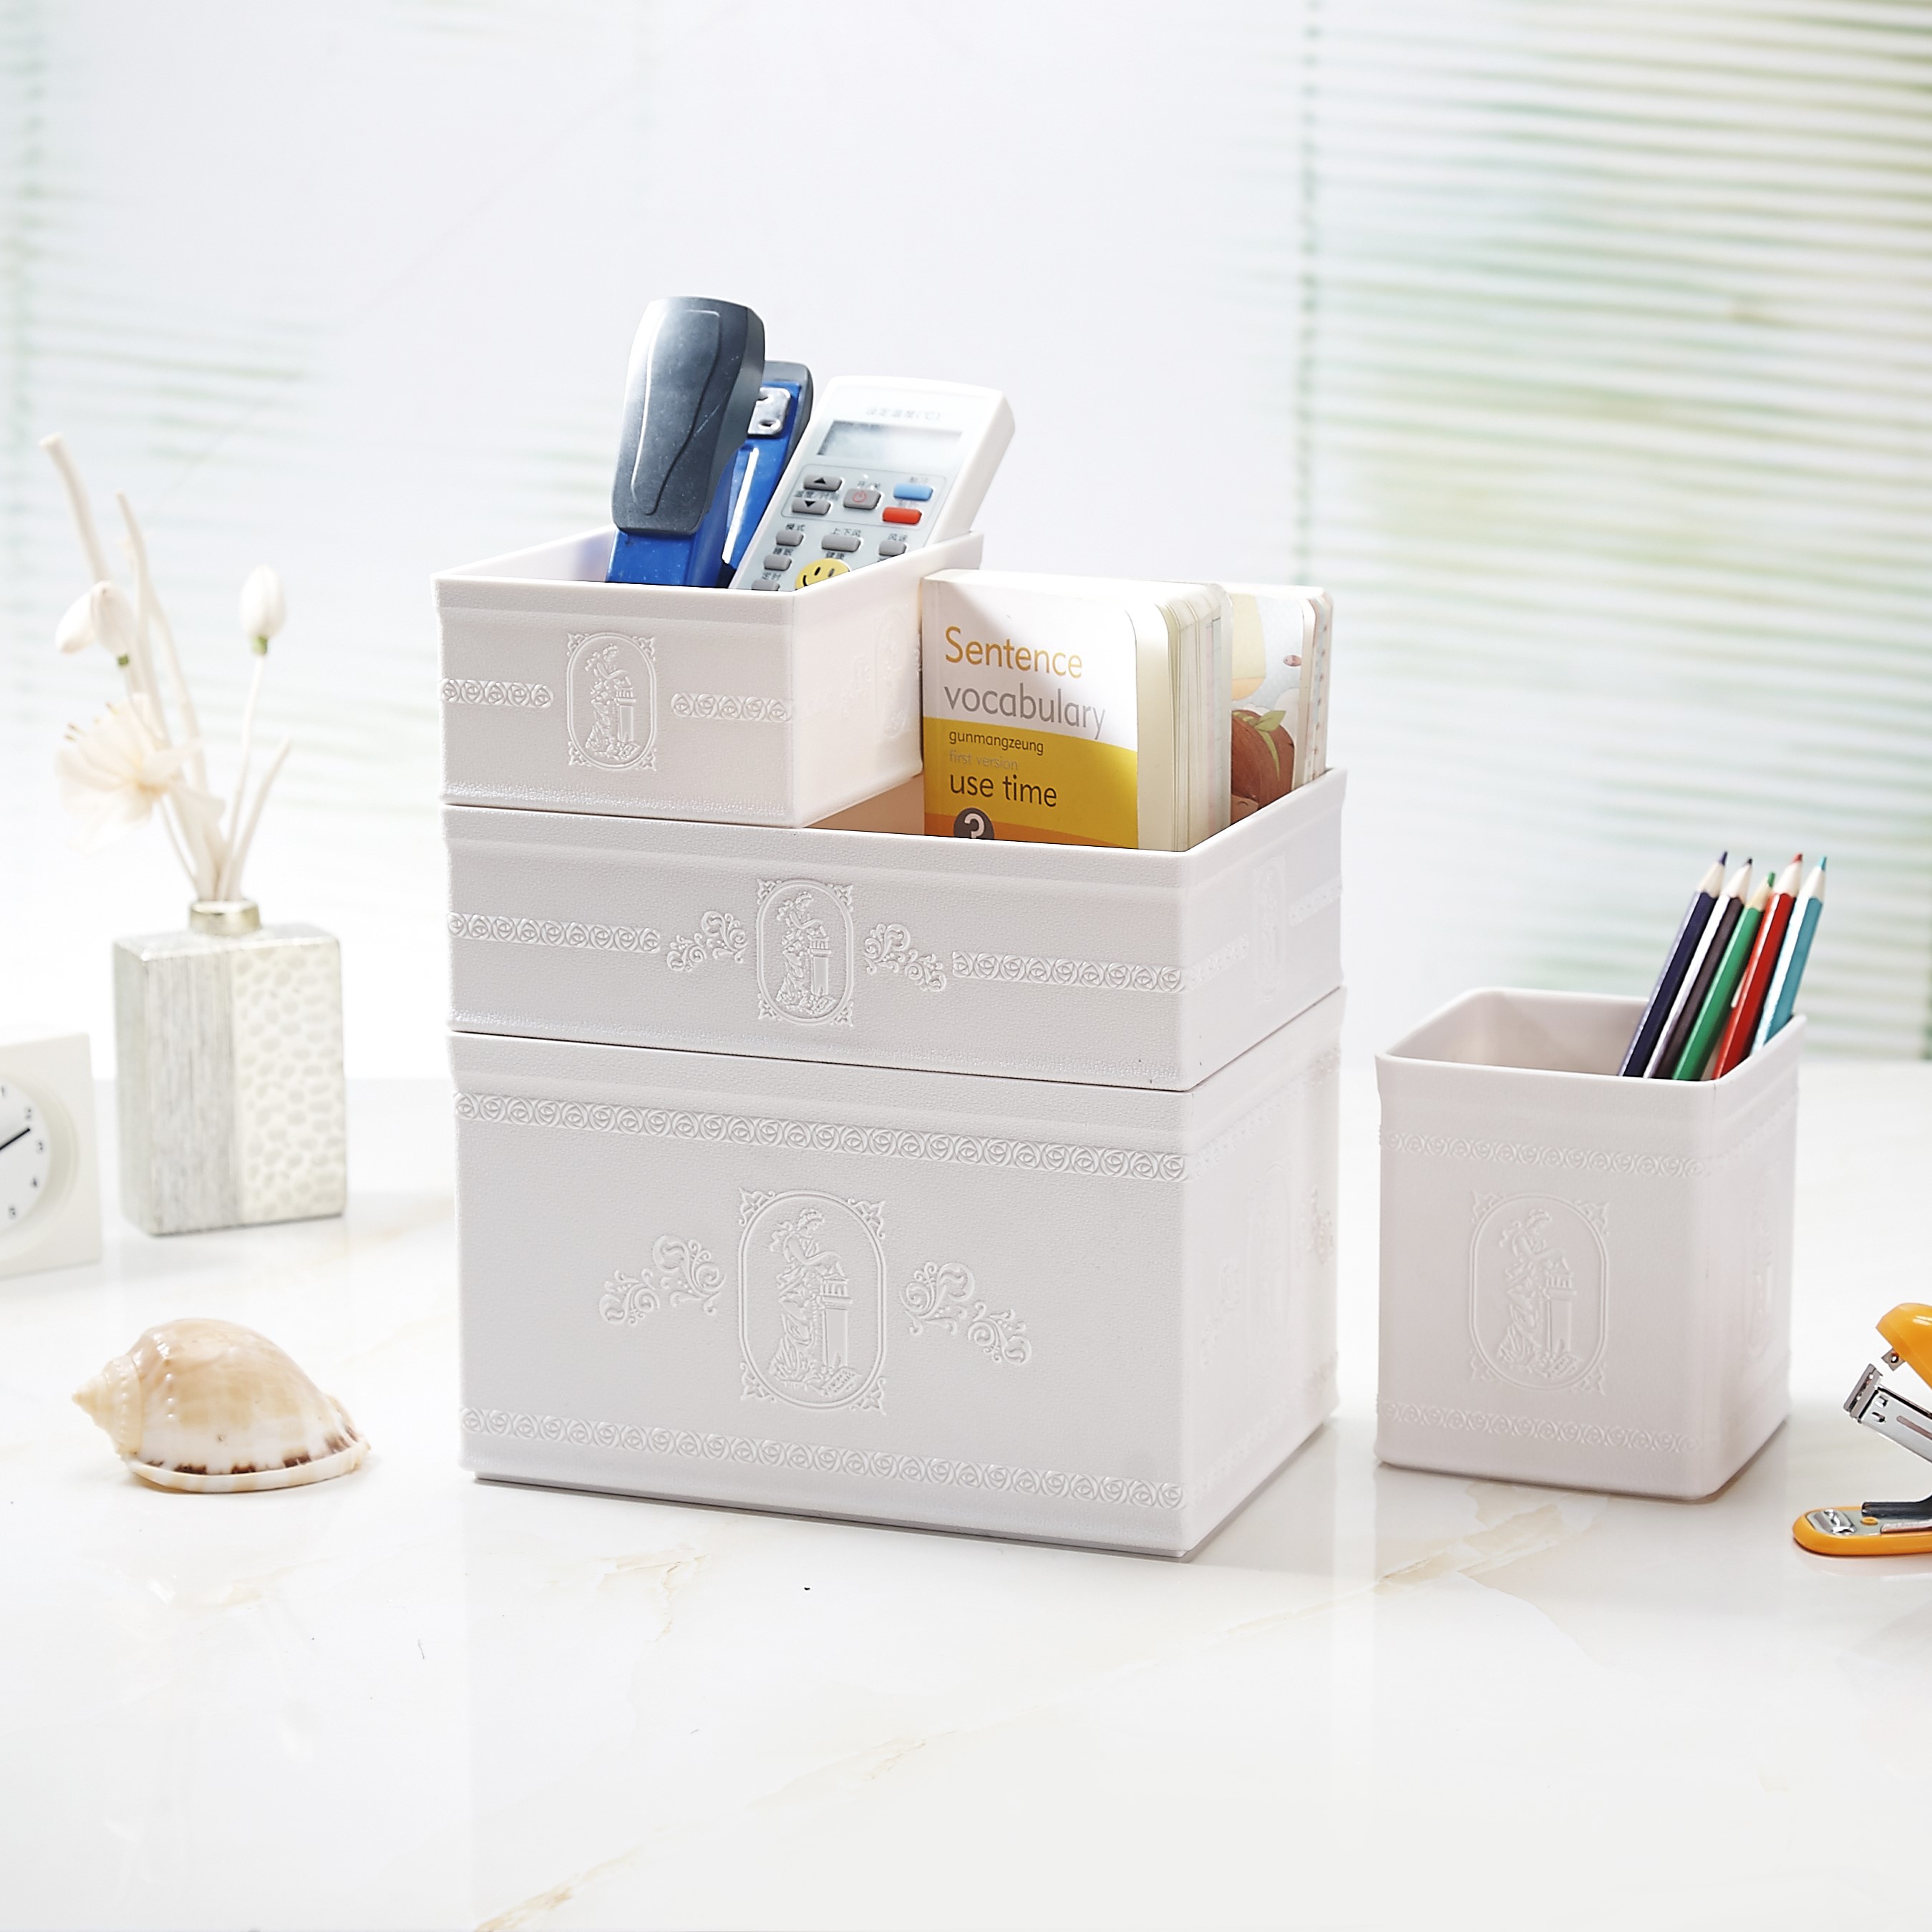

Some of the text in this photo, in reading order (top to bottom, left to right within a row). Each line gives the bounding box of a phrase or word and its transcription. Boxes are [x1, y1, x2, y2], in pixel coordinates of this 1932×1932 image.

[946, 625, 1083, 679] Sentence
[944, 682, 1106, 739] vocabulary
[948, 729, 1044, 755] gunmangzeung
[949, 749, 1019, 770] first version
[950, 772, 1057, 807] use time
